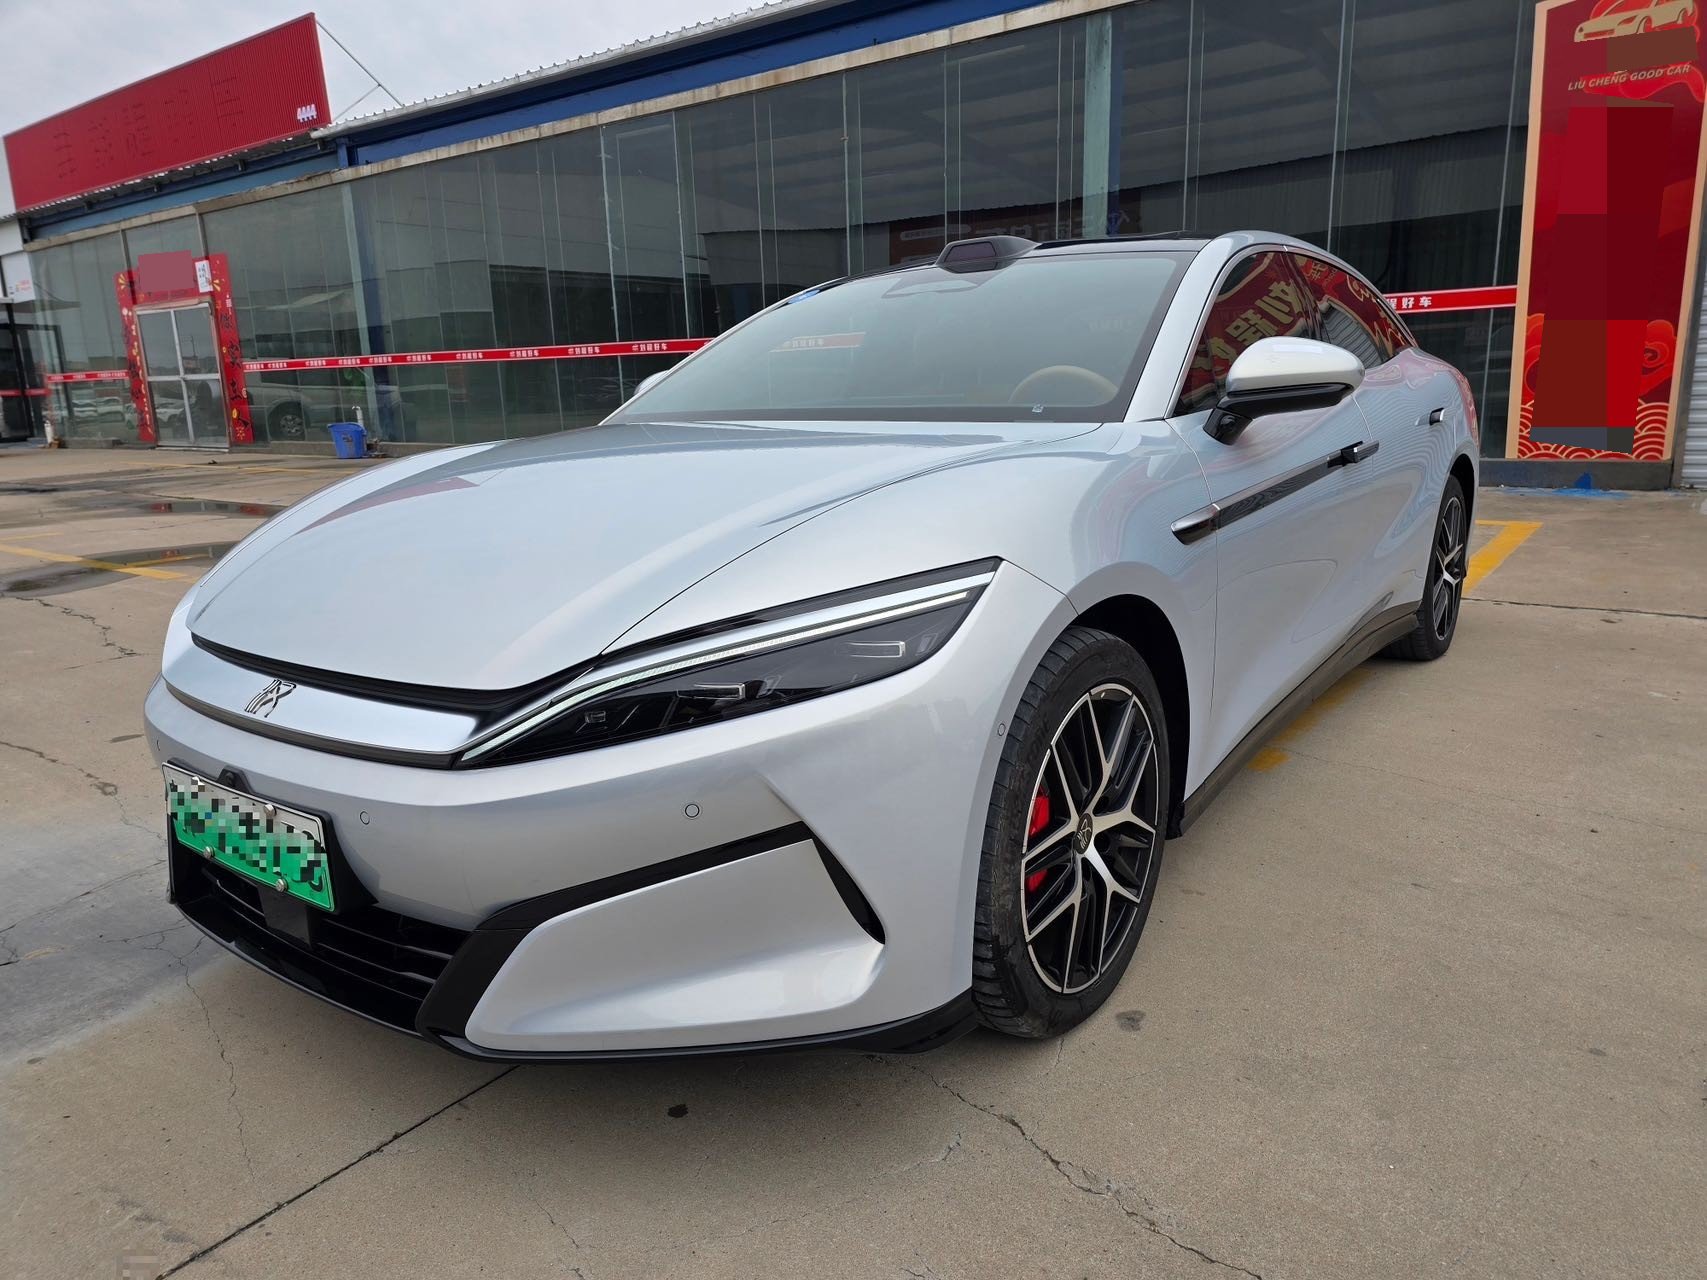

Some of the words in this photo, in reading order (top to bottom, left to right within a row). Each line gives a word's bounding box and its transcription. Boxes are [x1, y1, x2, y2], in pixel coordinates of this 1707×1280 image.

[1568, 81, 1586, 90] LIU
[1588, 73, 1627, 87] CHENG
[1630, 70, 1664, 81] GOOD
[1666, 64, 1690, 75] CAR
